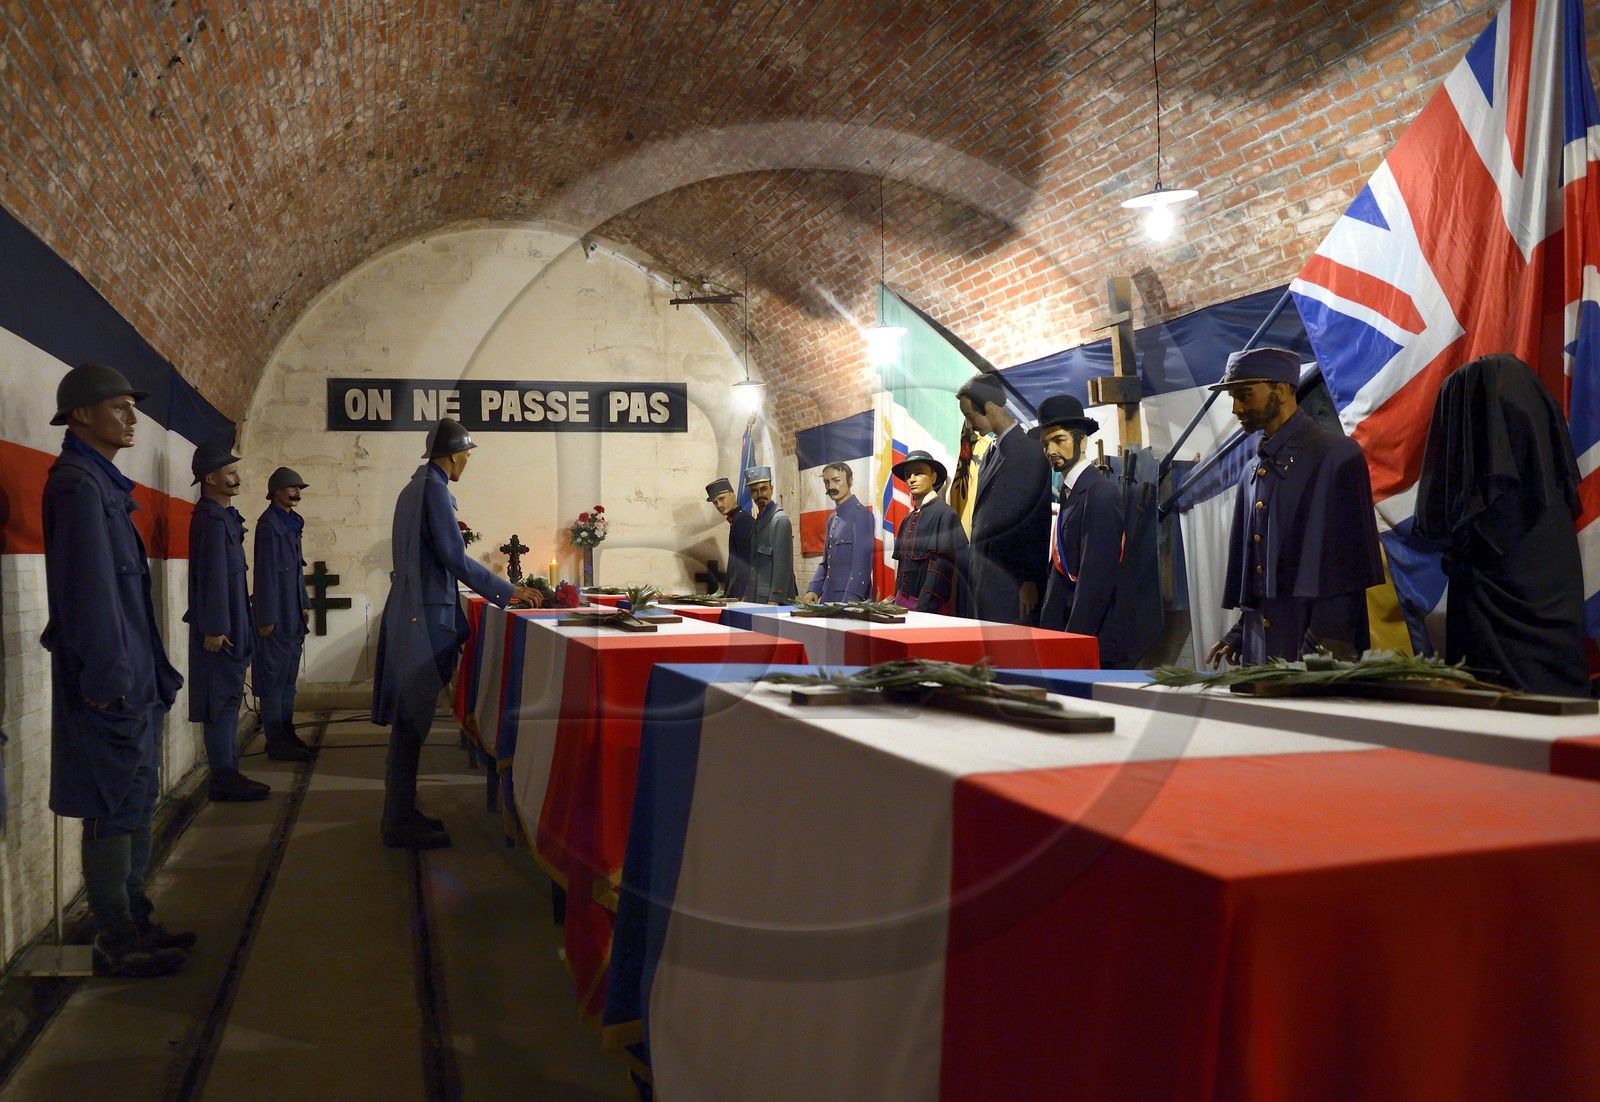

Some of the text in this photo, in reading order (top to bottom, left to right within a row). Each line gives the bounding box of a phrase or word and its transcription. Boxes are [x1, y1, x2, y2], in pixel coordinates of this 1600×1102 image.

[344, 388, 670, 424] ON NE PASSE PAS
